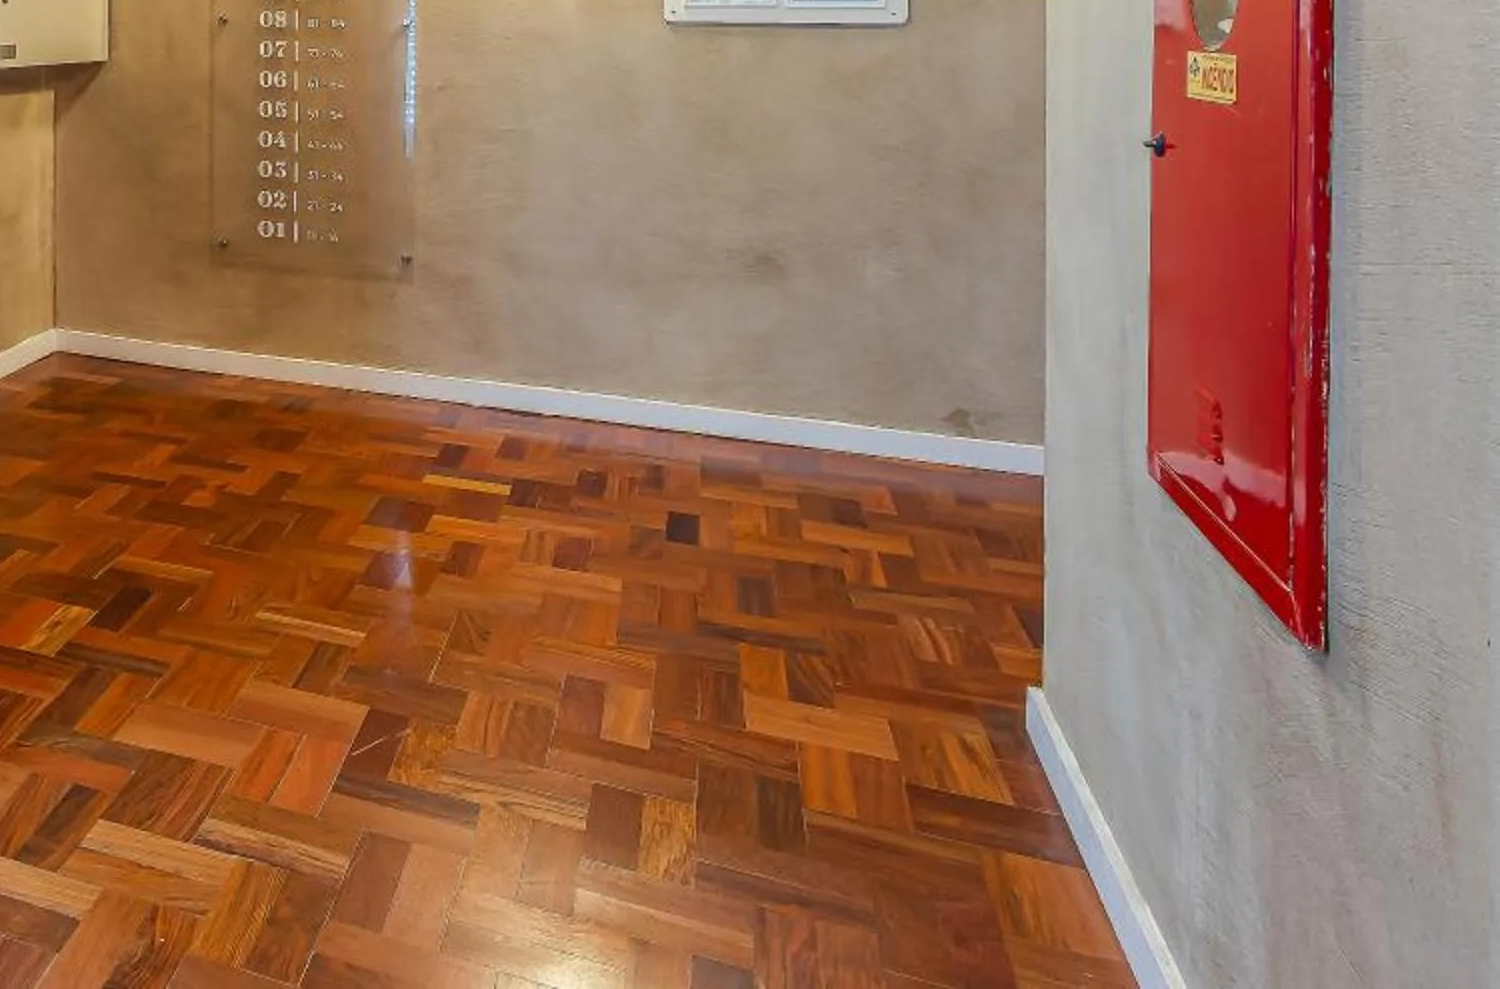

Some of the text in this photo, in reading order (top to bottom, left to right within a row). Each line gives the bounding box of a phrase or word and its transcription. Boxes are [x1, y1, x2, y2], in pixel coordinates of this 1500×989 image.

[260, 10, 287, 28] 08
[260, 40, 287, 58] 07
[260, 70, 287, 88] 06
[260, 100, 287, 118] 05
[260, 130, 286, 148] 04
[259, 160, 287, 178] 03
[258, 190, 287, 208] 02
[258, 220, 285, 238] 01
